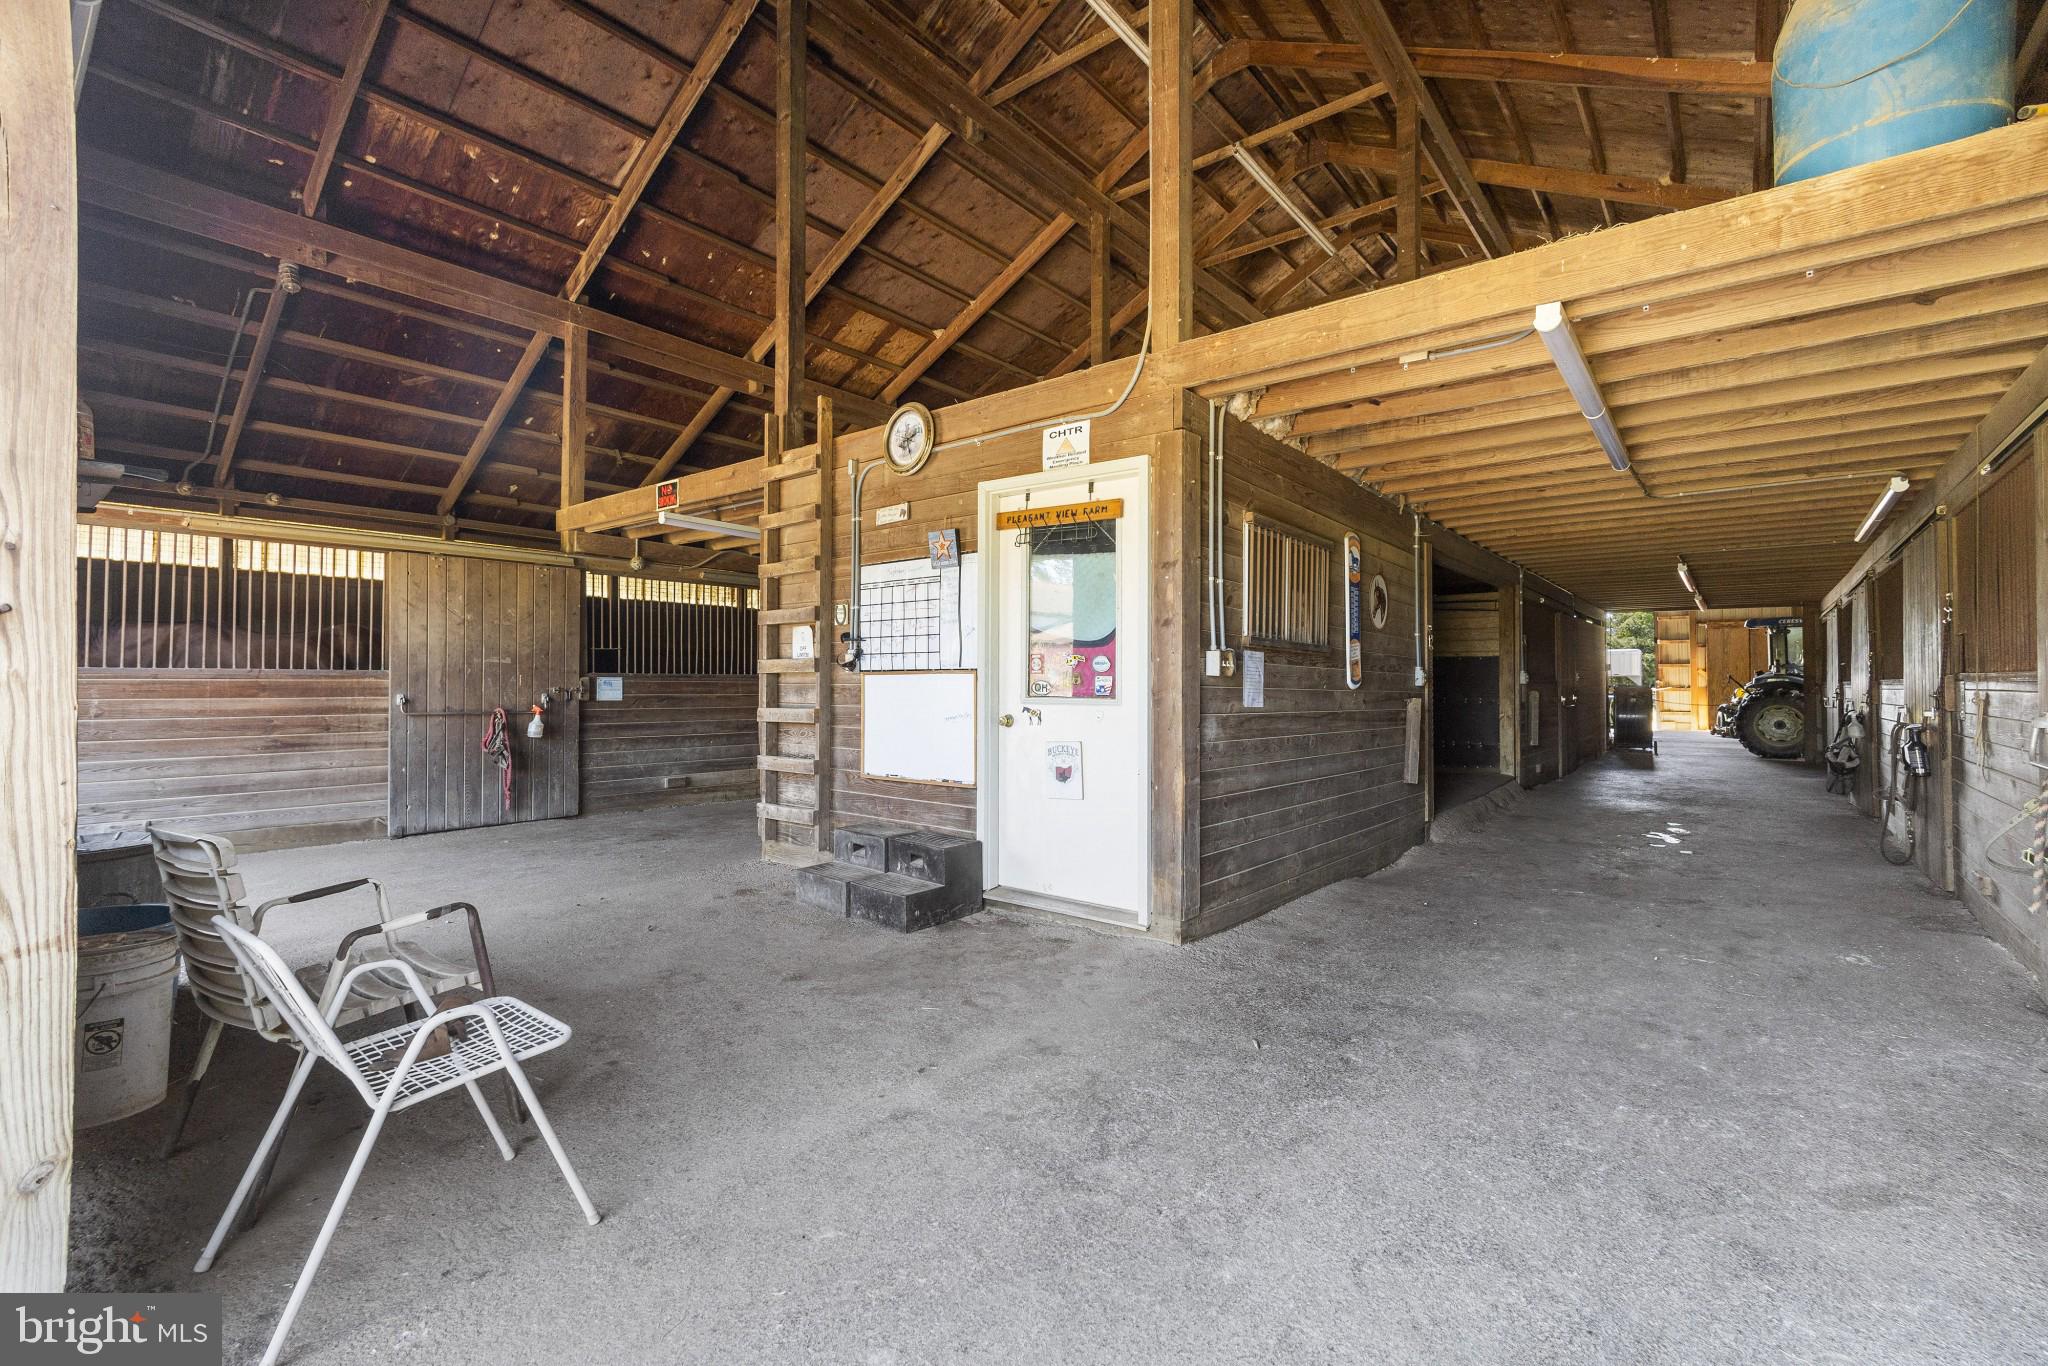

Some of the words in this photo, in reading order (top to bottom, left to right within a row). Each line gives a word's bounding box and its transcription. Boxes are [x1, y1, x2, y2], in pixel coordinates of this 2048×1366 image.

[1049, 425, 1083, 439] CHTR
[661, 485, 673, 496] NO
[1006, 511, 1050, 524] PLEASANT
[1056, 508, 1078, 519] VIEW
[1083, 505, 1109, 515] FARM
[1034, 682, 1048, 693] QH
[1047, 744, 1080, 757] BUCKEYE
